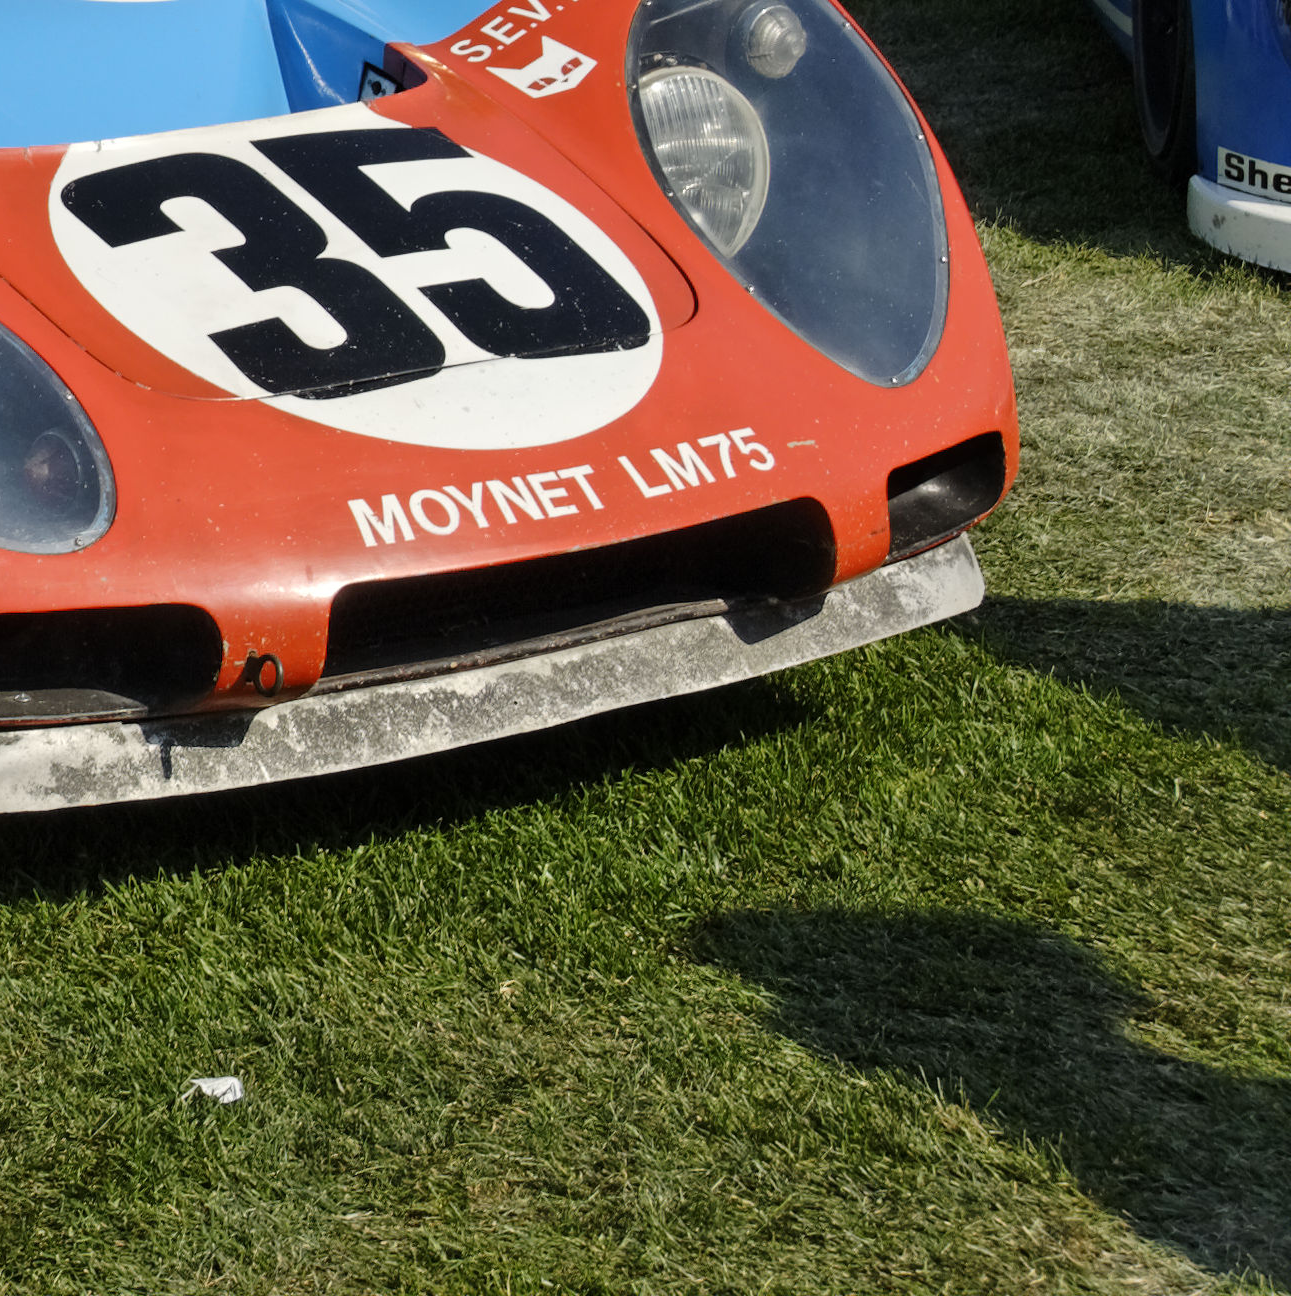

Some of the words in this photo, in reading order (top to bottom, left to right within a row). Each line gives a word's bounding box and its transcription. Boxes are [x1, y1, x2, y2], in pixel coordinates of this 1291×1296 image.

[1224, 152, 1291, 195] She
[60, 126, 651, 401] 35
[347, 464, 605, 549] MOYNET
[616, 427, 776, 499] LM75
